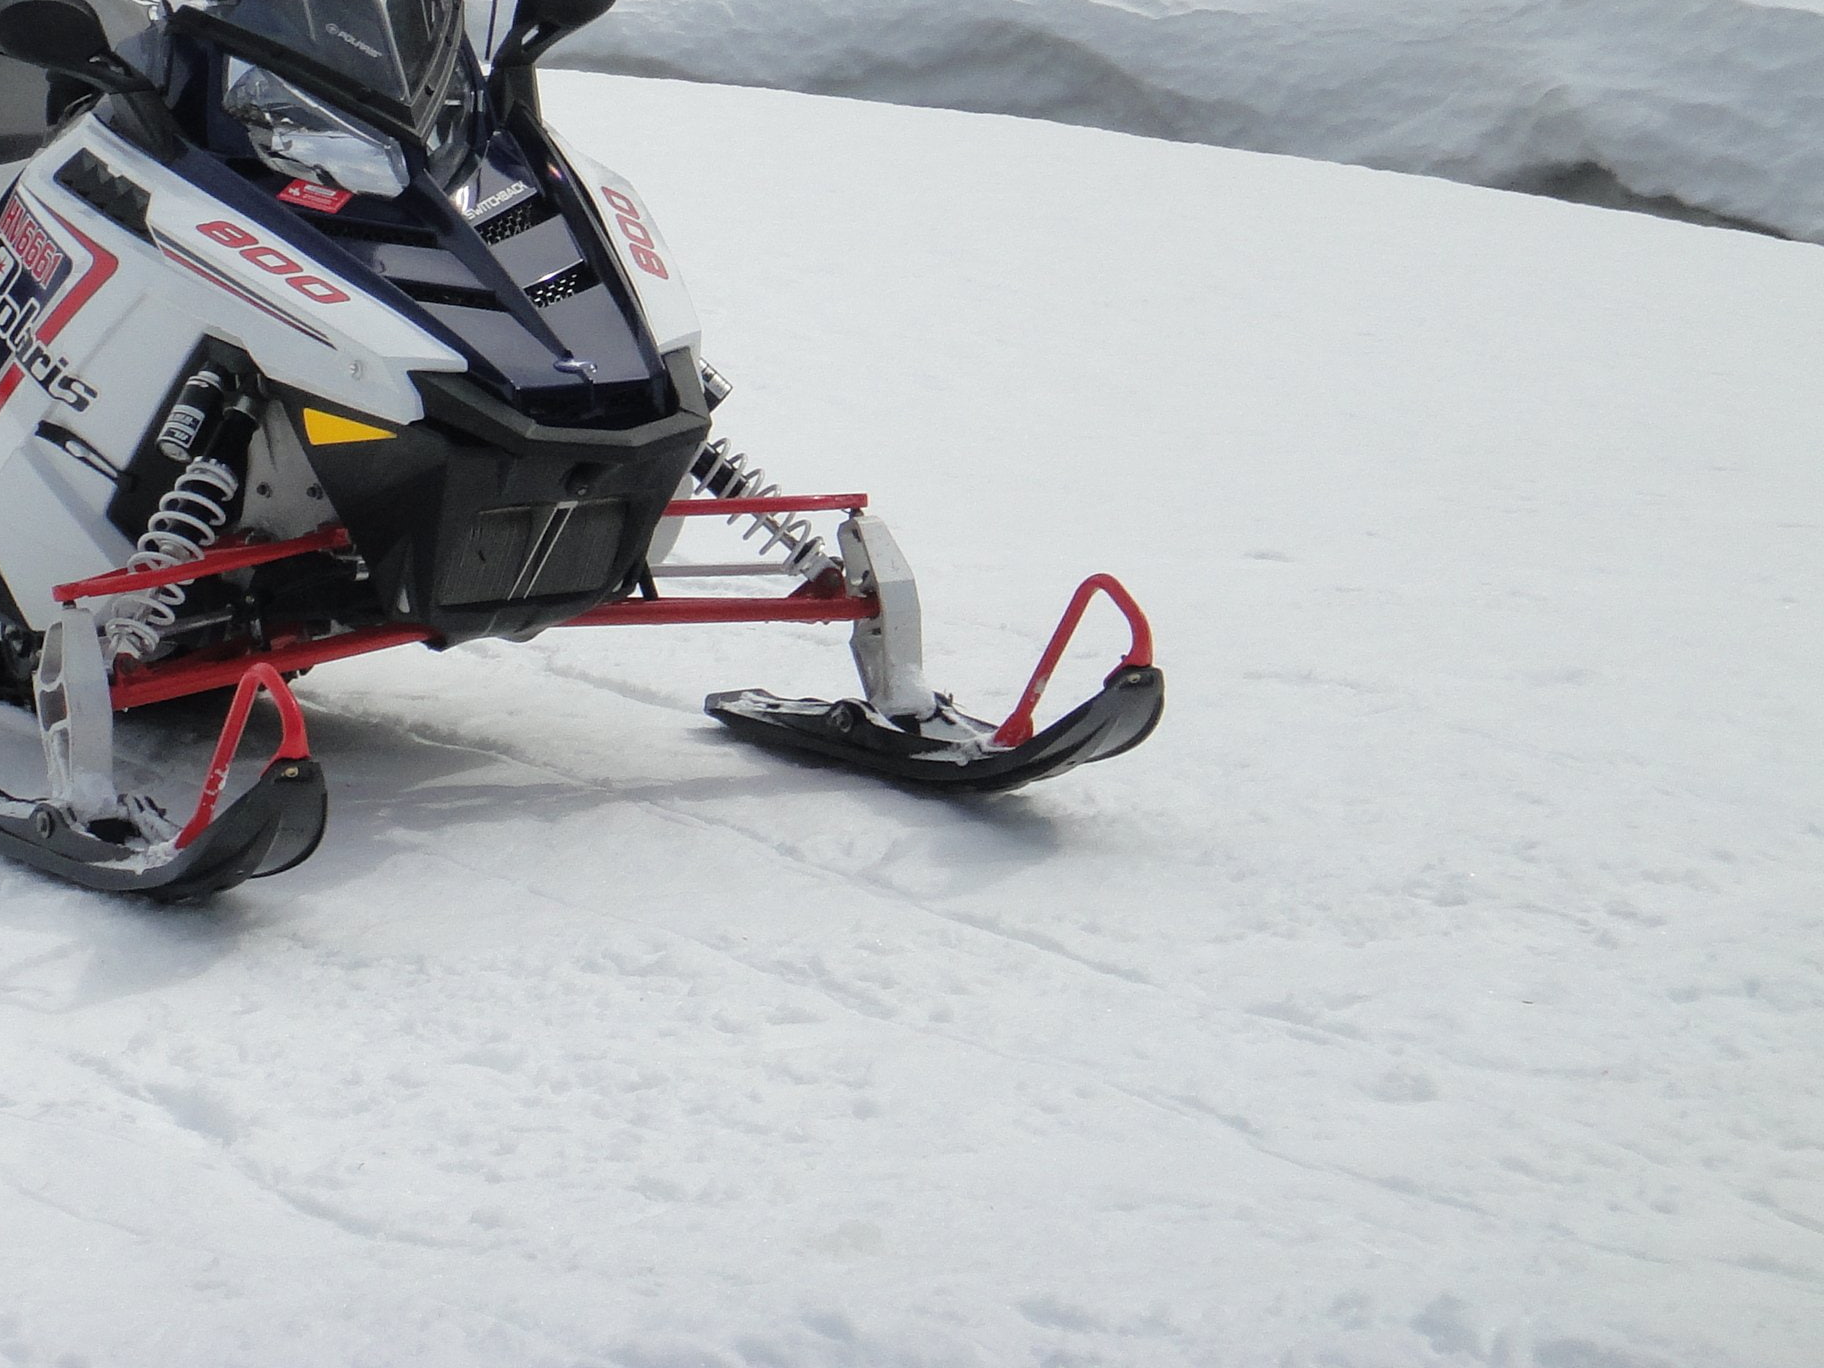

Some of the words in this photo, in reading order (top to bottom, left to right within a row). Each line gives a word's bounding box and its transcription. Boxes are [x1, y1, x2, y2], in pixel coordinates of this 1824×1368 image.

[463, 180, 529, 220] SWITCHBACK
[600, 185, 670, 281] 800
[196, 220, 351, 304] 800
